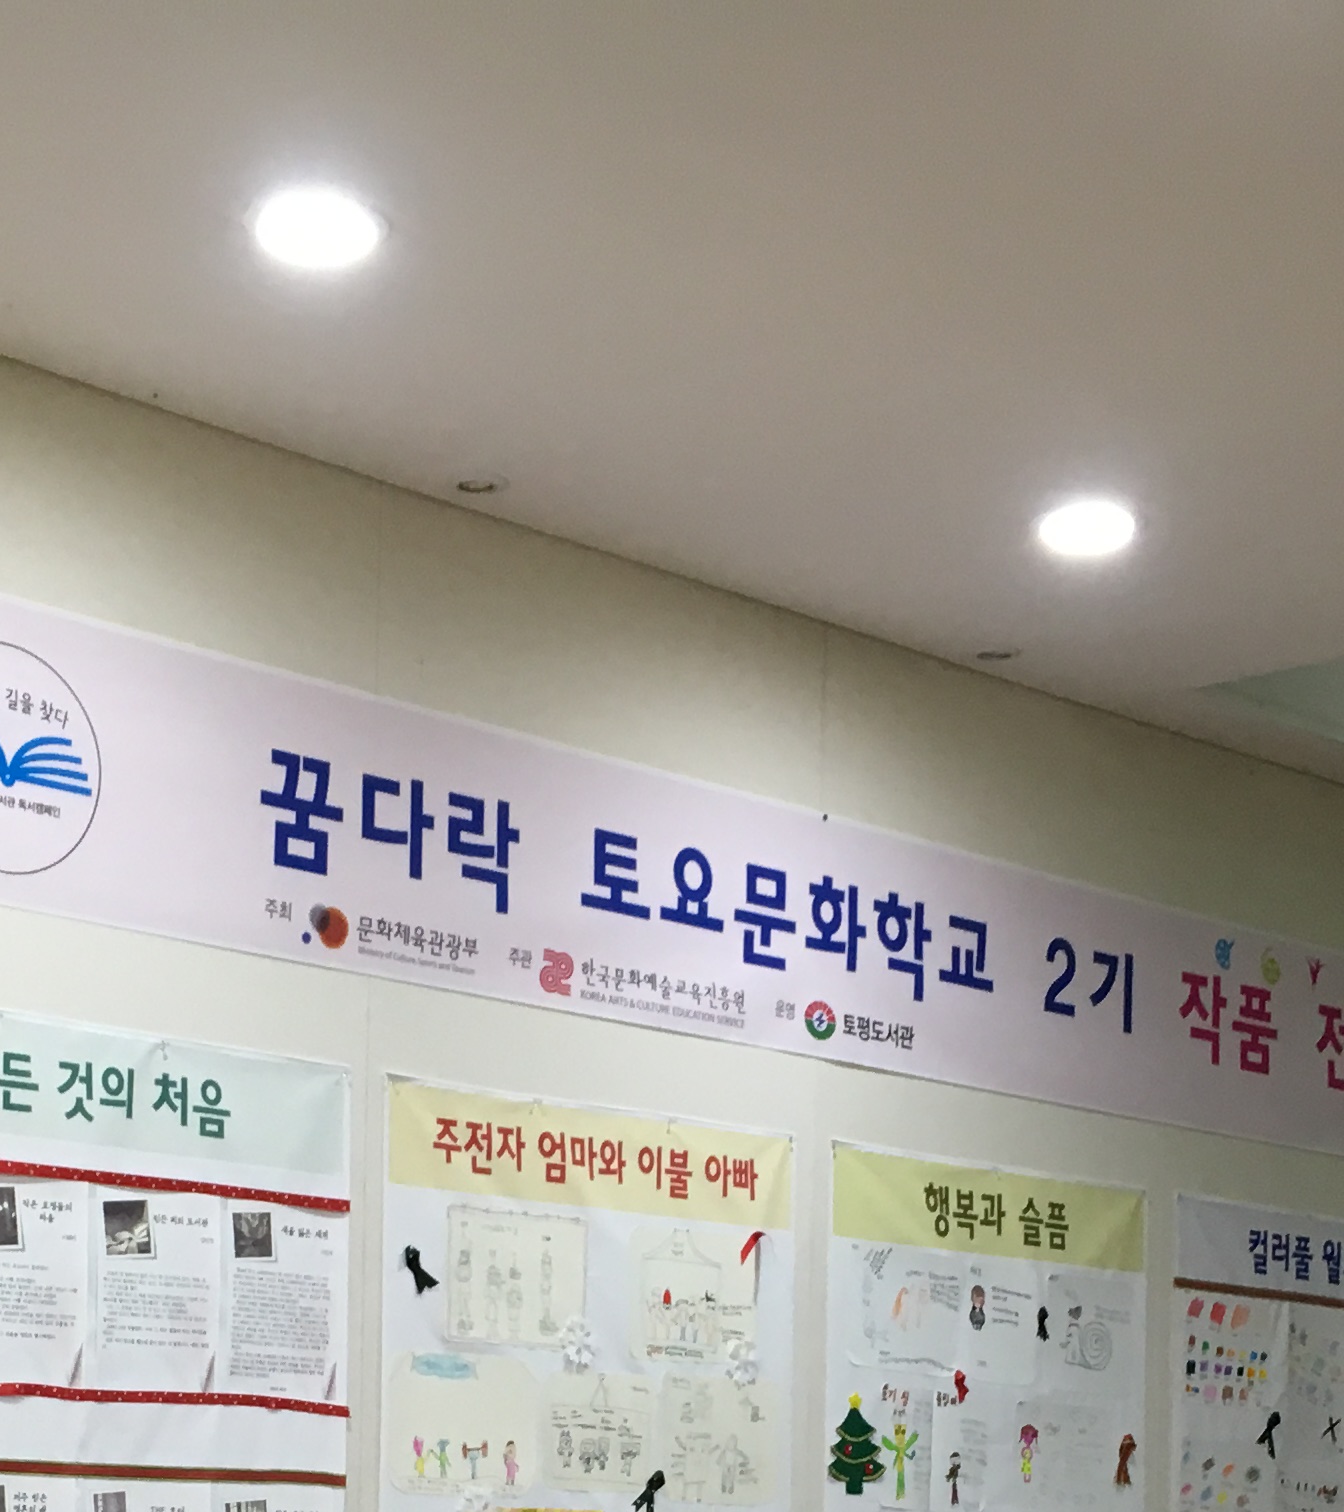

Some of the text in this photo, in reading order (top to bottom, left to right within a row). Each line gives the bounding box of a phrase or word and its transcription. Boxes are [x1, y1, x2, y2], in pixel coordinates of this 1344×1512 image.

[5, 687, 34, 715] 길을
[39, 699, 69, 730] 찾다
[260, 748, 520, 915] 꿈다락
[581, 827, 994, 1003] 토요문화학교
[1043, 936, 1135, 1033] 2기
[1179, 970, 1279, 1075] 작품
[264, 898, 293, 923] 주최
[356, 915, 480, 961] 문화체육관광부
[508, 947, 533, 970] 주관
[580, 957, 747, 1016] 한국문화예술교육진흥원
[842, 1011, 915, 1050] 토평도서관
[56, 1060, 135, 1122] 것의
[152, 1070, 231, 1139] 처음
[433, 1117, 759, 1201] 주전자 엄마와 이불 아빠
[924, 1182, 1070, 1251] 행복과 슬픔
[1248, 1229, 1314, 1281] 컬러풀
